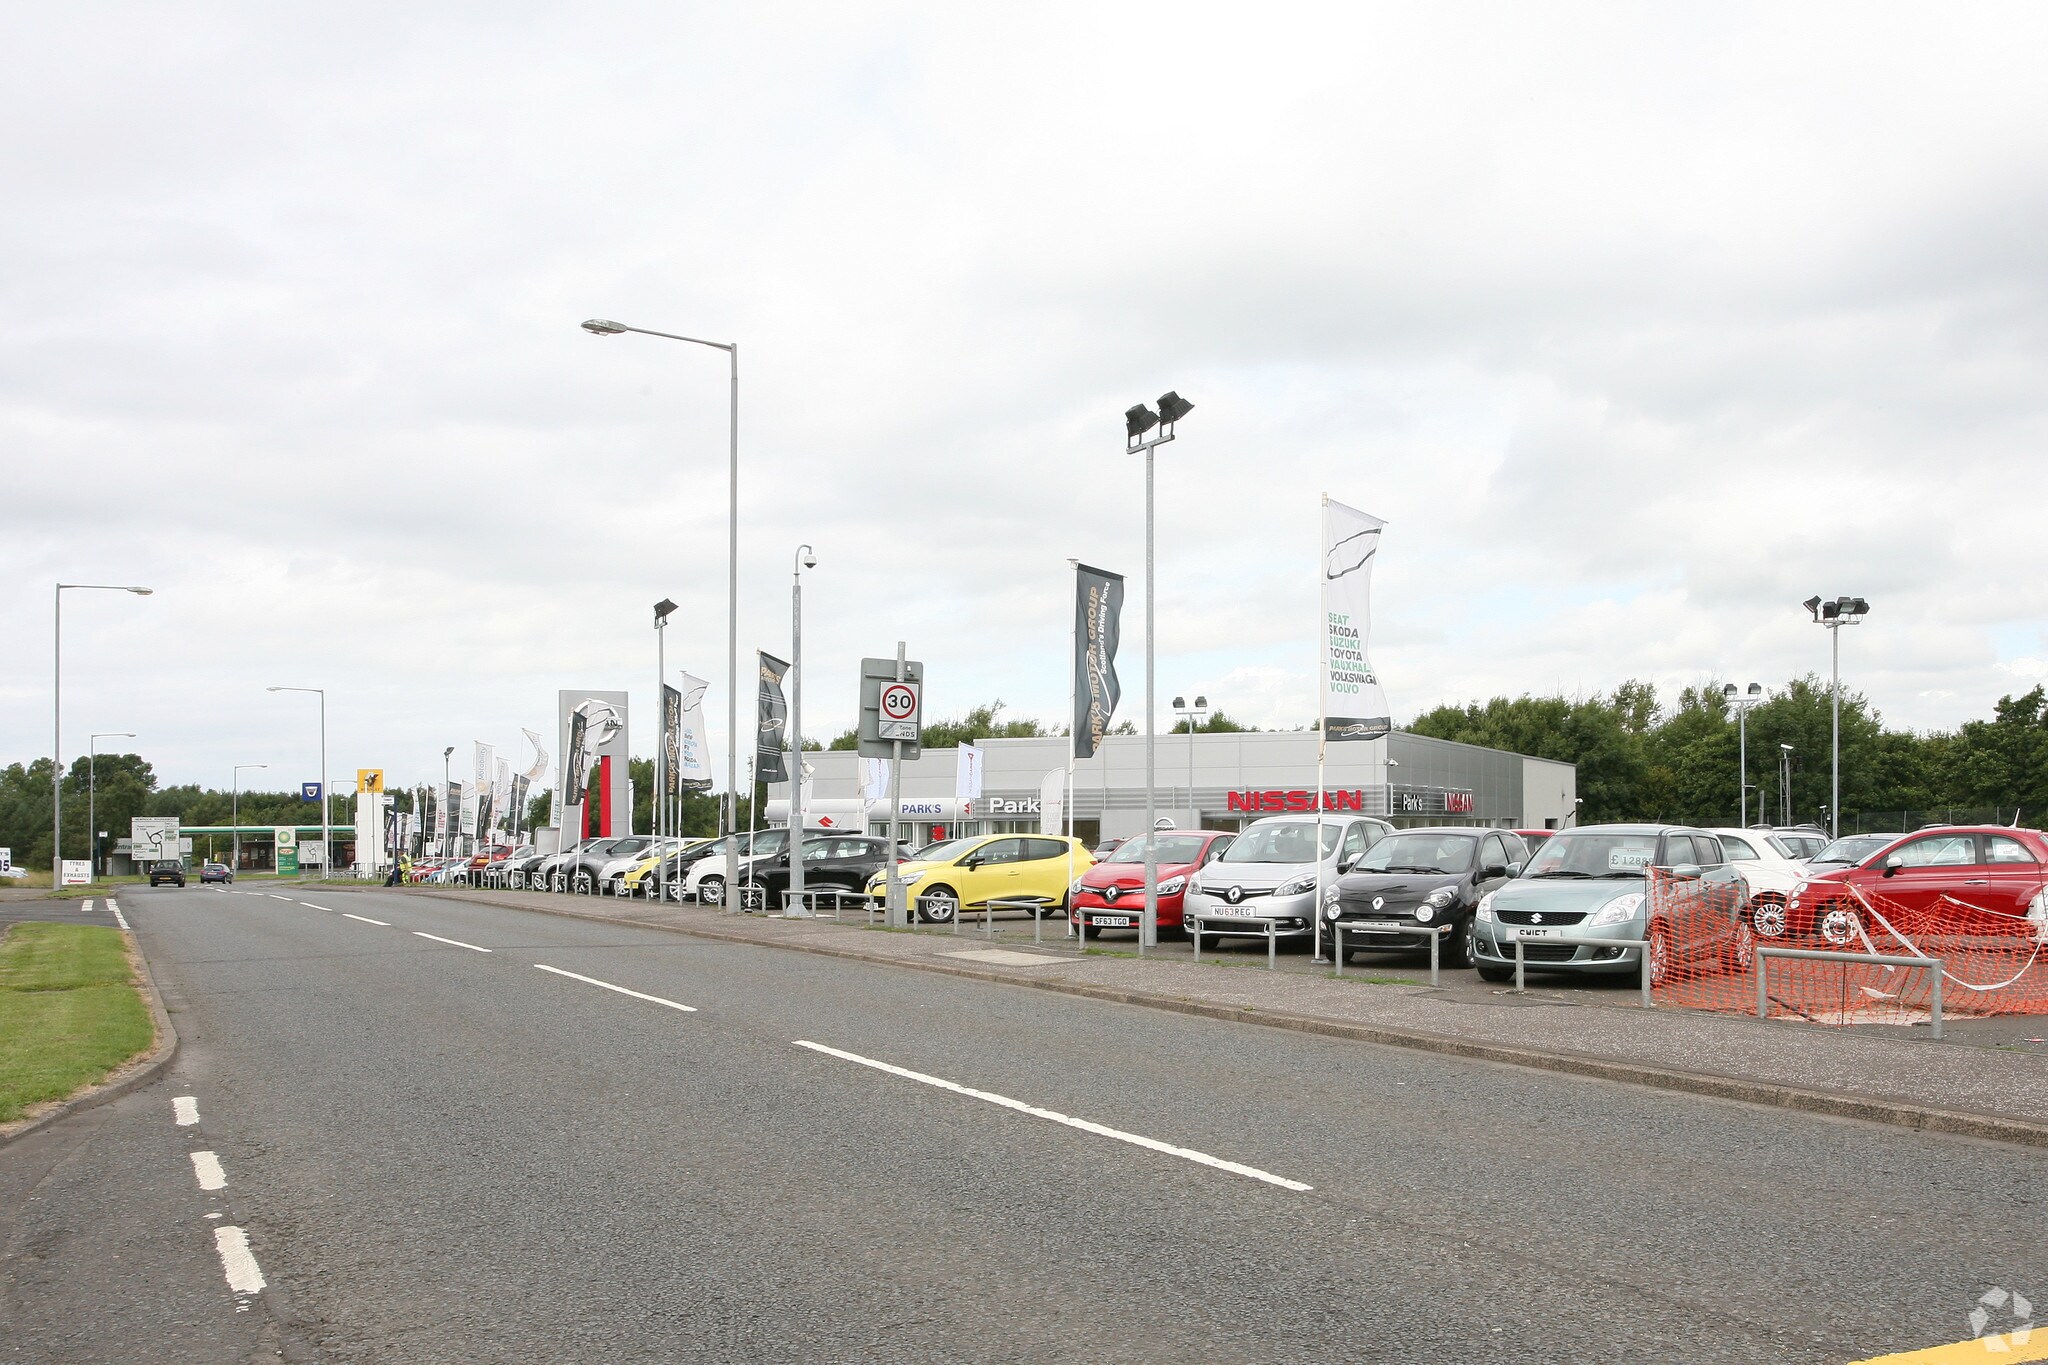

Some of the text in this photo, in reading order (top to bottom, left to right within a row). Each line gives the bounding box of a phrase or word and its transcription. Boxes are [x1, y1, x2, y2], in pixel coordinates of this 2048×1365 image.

[1100, 581, 1110, 604] Force
[1087, 586, 1099, 641] GROUP
[1098, 604, 1108, 634] Driving
[1328, 612, 1350, 626] SEAT
[1329, 624, 1359, 638] SKODA
[1329, 635, 1361, 650] SUZUKI
[1330, 647, 1363, 662] TOYOTA
[1088, 642, 1101, 698] MOTOR
[1330, 682, 1359, 694] VOLVO
[887, 694, 912, 709] 30
[1227, 789, 1363, 812] NISSAN
[1402, 793, 1423, 811] Park's
[901, 804, 942, 814] PARK'S
[1094, 917, 1113, 925] SF63
